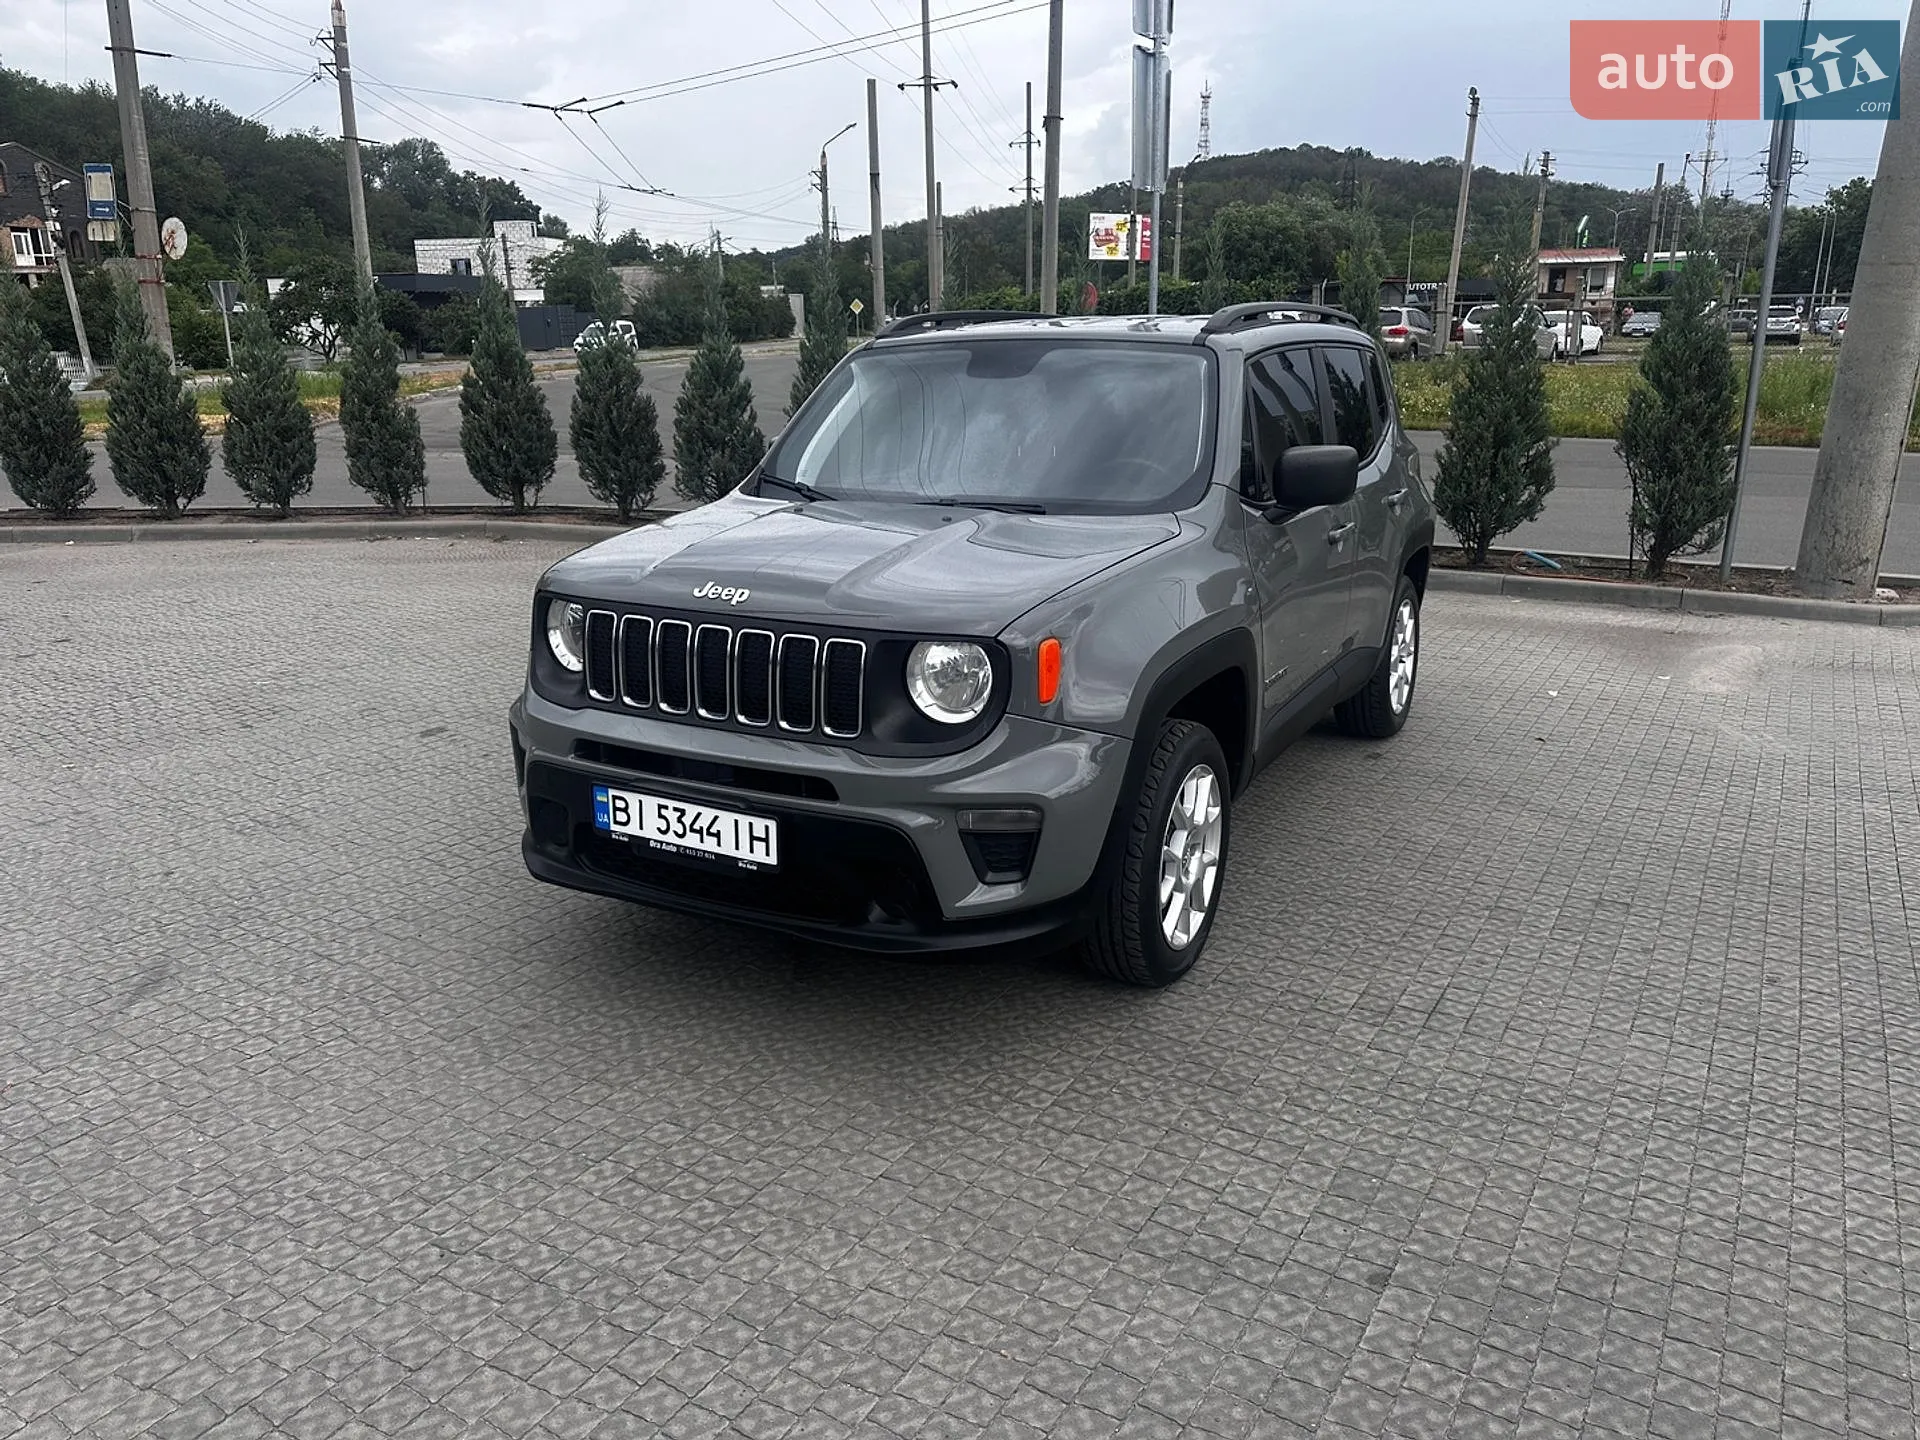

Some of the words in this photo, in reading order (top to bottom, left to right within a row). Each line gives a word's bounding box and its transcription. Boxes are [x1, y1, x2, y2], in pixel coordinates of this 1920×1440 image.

[693, 580, 751, 606] Jeep
[598, 813, 609, 824] UA
[612, 795, 643, 830] BI
[657, 803, 721, 847] 5344
[734, 819, 770, 857] IH
